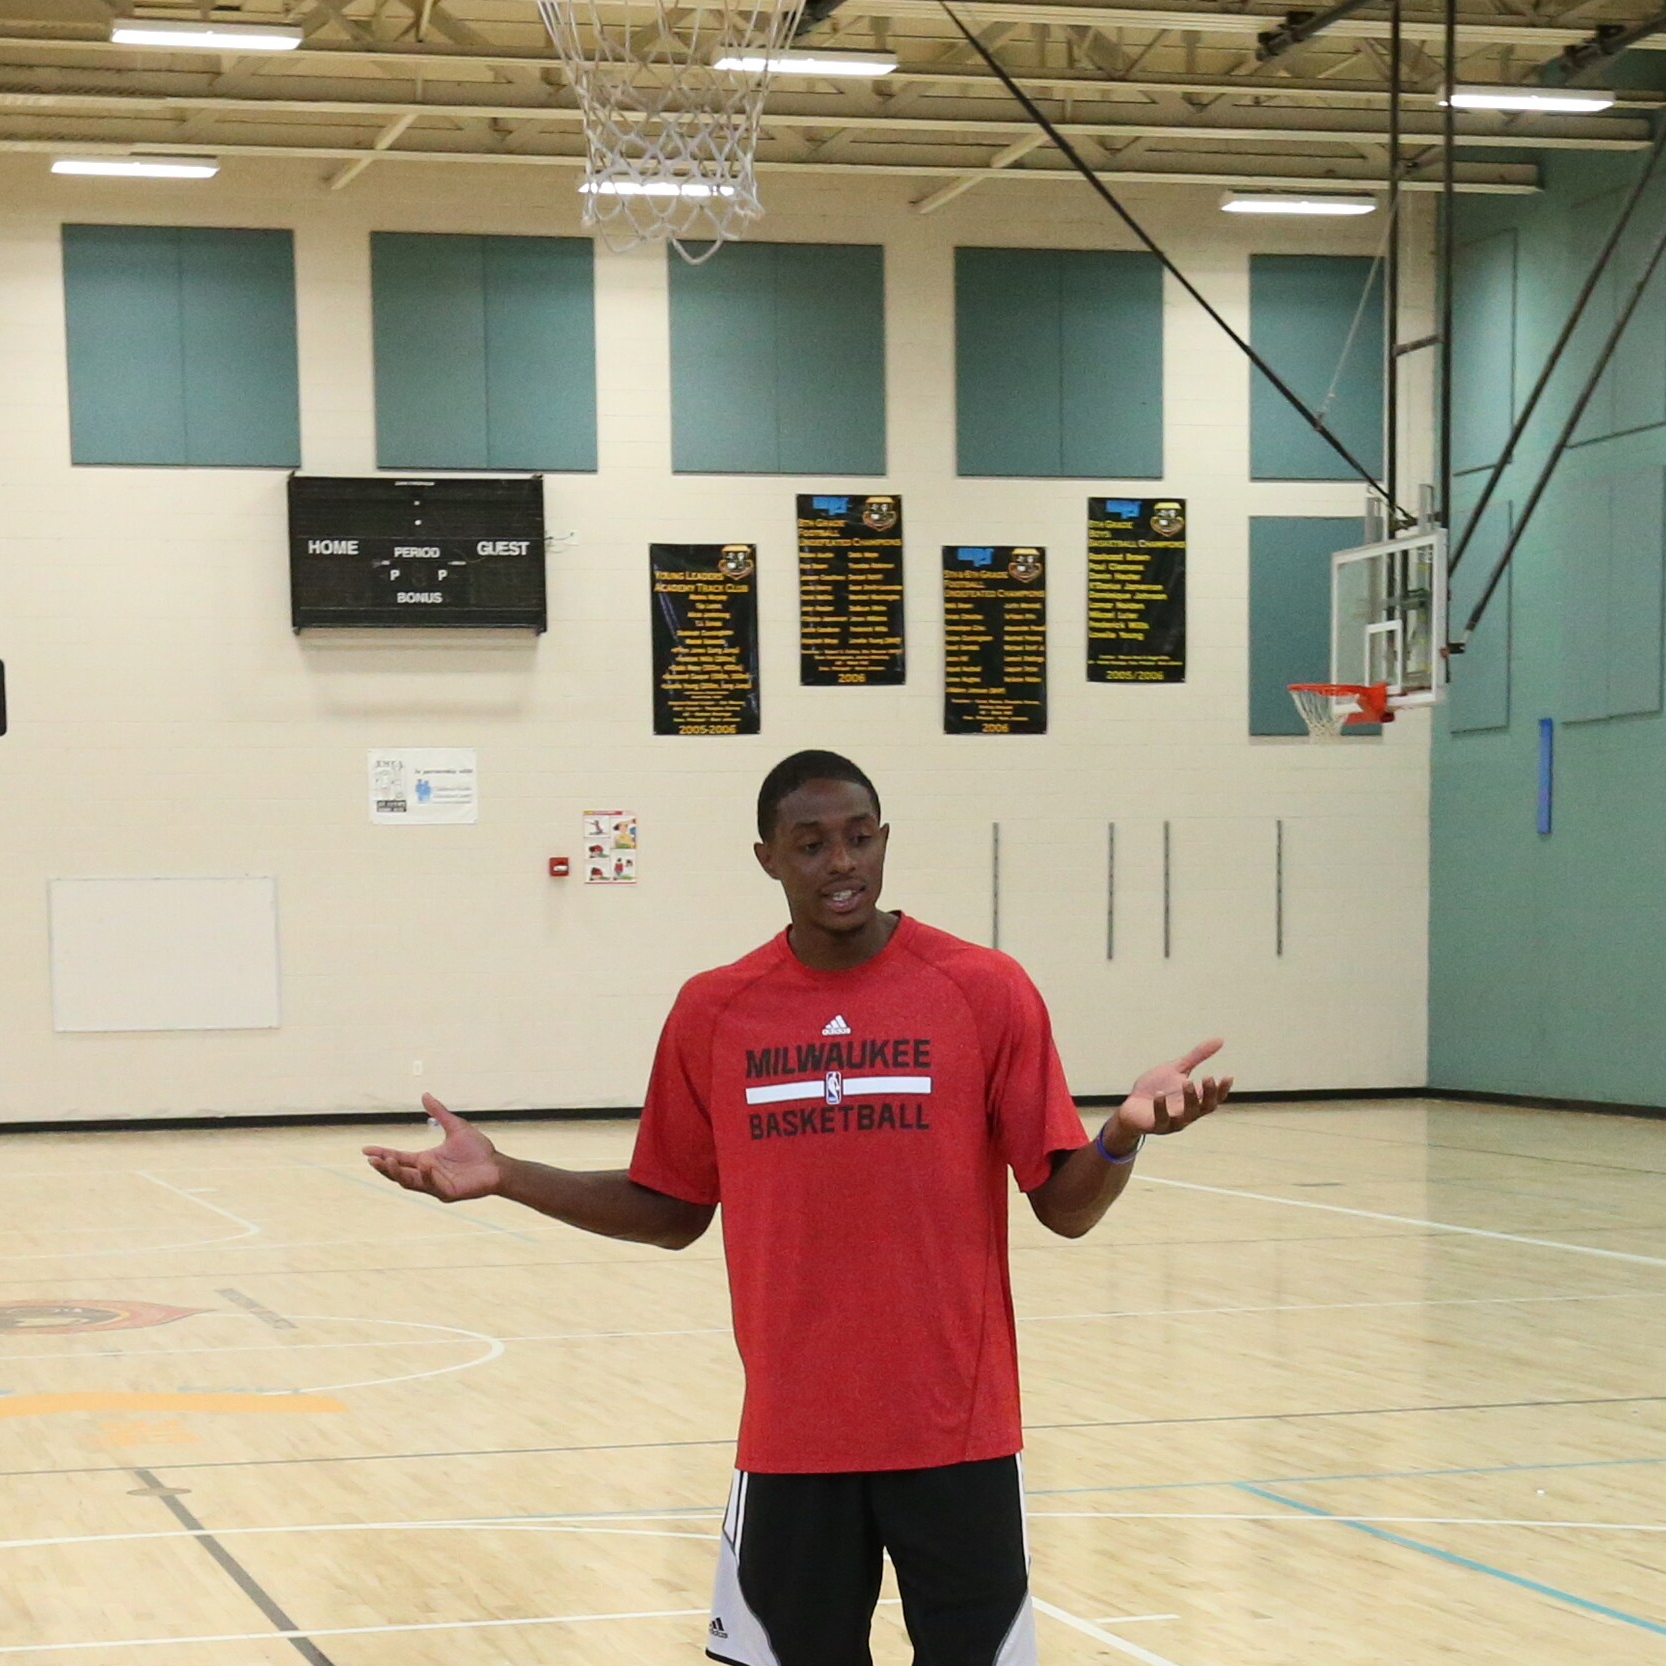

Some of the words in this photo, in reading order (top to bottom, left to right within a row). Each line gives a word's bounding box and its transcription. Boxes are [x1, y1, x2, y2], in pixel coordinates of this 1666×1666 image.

[307, 540, 360, 555] HOME
[393, 547, 441, 559] PERIOD
[476, 541, 531, 557] GUEST
[389, 569, 400, 581] P
[438, 569, 448, 581] P
[397, 592, 443, 604] BONUS
[745, 1038, 932, 1079] MILWAUKEE
[748, 1103, 931, 1141] BASKETBALL
